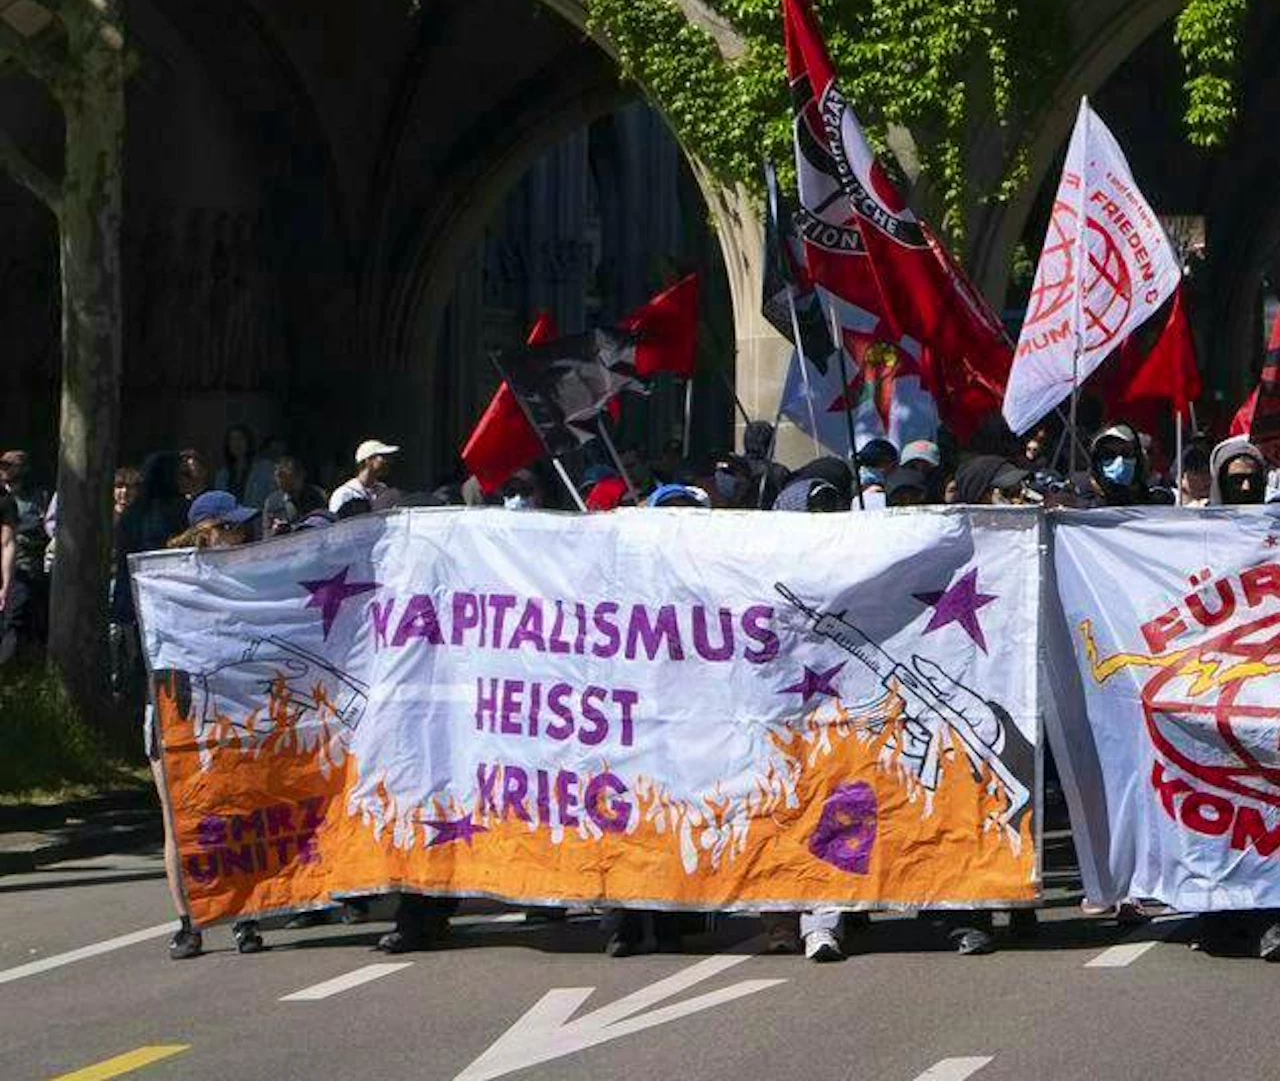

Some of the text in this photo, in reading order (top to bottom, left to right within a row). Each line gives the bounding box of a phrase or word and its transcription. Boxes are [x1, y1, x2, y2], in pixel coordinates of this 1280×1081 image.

[1091, 190, 1156, 281] FRIEDEN
[371, 593, 781, 664] KAPITALISMUS
[475, 677, 639, 747] HEISST
[476, 762, 634, 834] KRIEG
